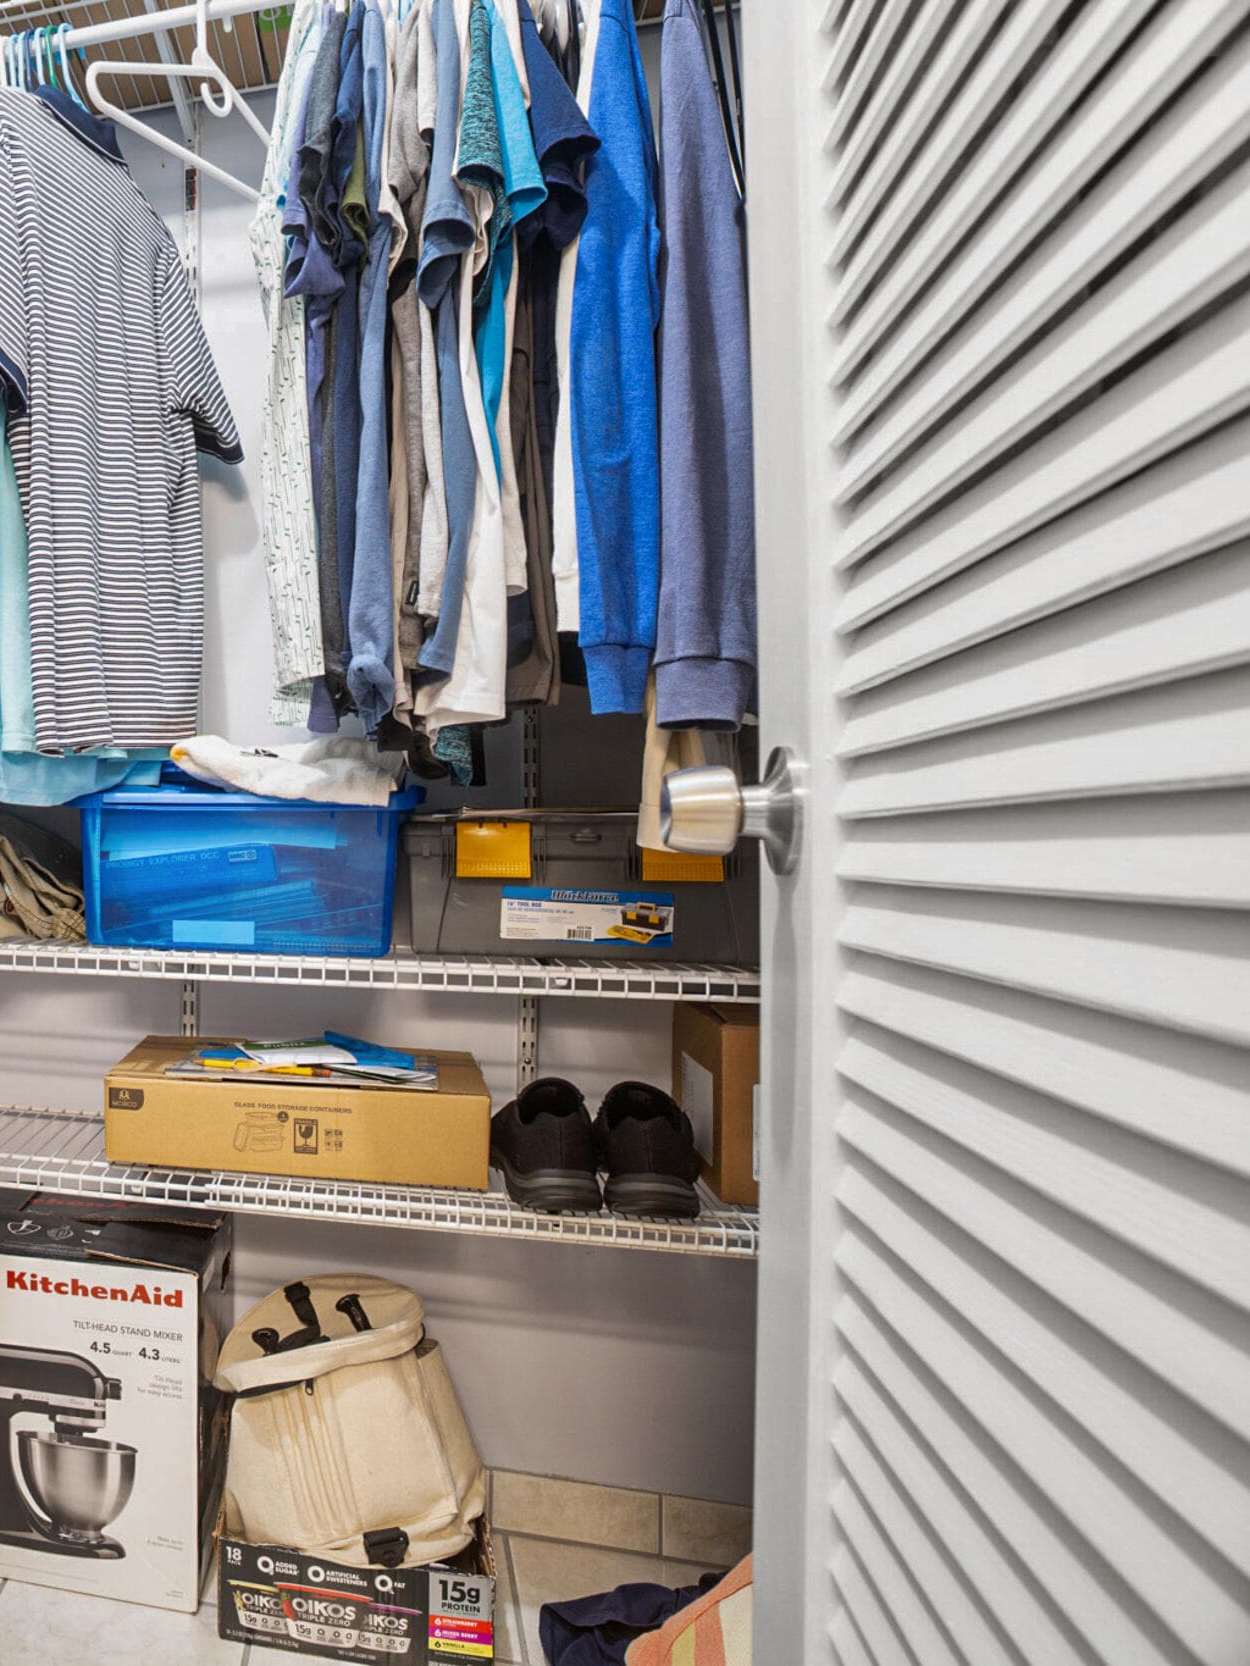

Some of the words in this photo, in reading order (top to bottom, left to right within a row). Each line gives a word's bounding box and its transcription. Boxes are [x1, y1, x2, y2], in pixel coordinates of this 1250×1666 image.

[6, 1270, 184, 1309] KitchenAid
[72, 1319, 118, 1334] TILT-HEAD
[120, 1326, 151, 1338] STAND
[153, 1330, 183, 1342] MIXER
[90, 1341, 111, 1354] 4.5
[138, 1347, 160, 1361] 4.3
[226, 1546, 242, 1561] 18
[275, 1561, 298, 1570] ADDED
[326, 1570, 360, 1581] ARTIFICIAL
[326, 1575, 368, 1588] SWEETENERS
[394, 1581, 407, 1589] FAT
[439, 1580, 480, 1604] 15g
[242, 1592, 283, 1610] OIKO
[441, 1602, 481, 1613] PROTEIN
[292, 1597, 356, 1621] OIKOS
[365, 1613, 409, 1631] IKOS
[434, 1617, 442, 1626] 6
[295, 1623, 311, 1635] 15g
[434, 1629, 442, 1637] 6
